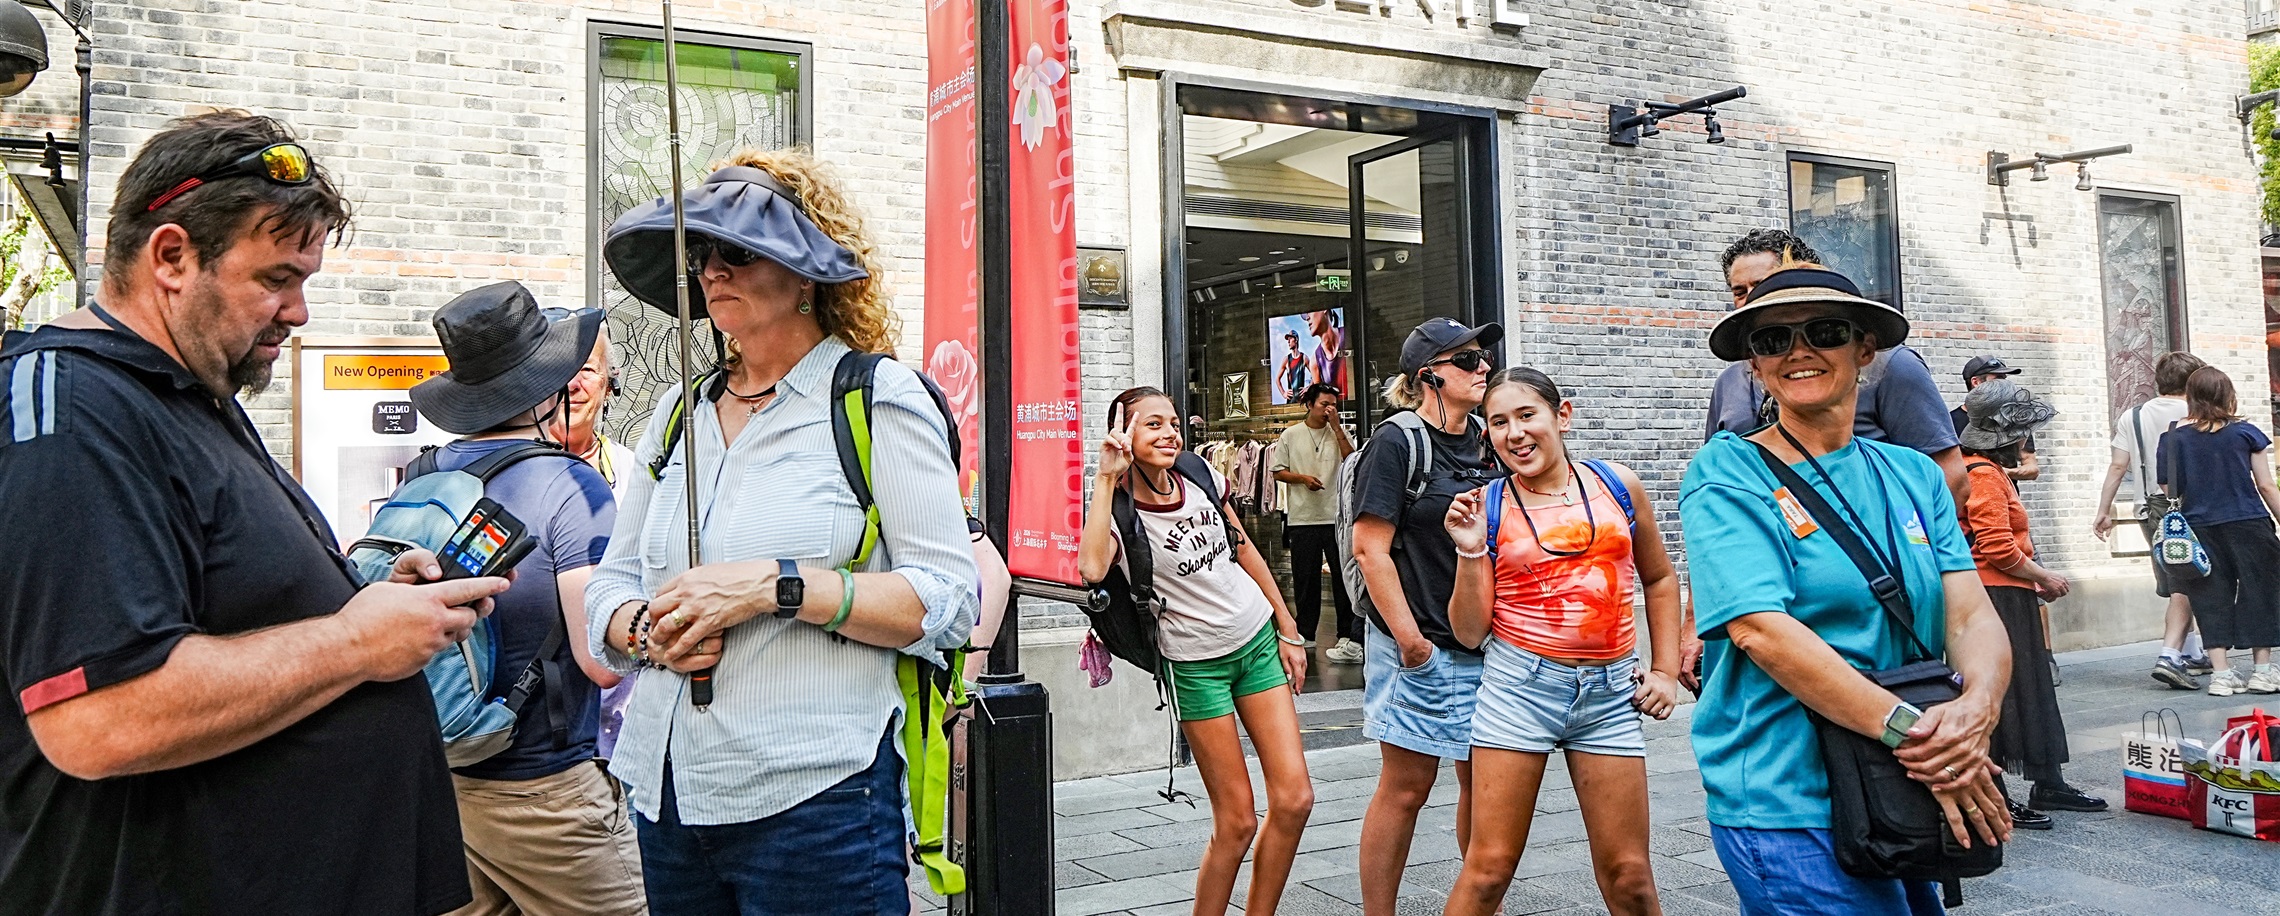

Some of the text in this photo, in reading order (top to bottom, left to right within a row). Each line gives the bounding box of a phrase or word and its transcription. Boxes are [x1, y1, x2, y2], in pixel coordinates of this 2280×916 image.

[334, 365, 364, 377] New
[367, 365, 424, 379] Opening
[378, 405, 410, 414] MEMO
[1017, 400, 1077, 423] 黄浦城市主会场
[1017, 428, 1077, 442] Huangpu City Main Venue
[1163, 510, 1219, 553] MEET ME
[1057, 541, 1079, 553] Shanghai
[1189, 532, 1208, 551] IN
[1176, 535, 1227, 576] Shanghai
[2212, 794, 2248, 811] KFC
